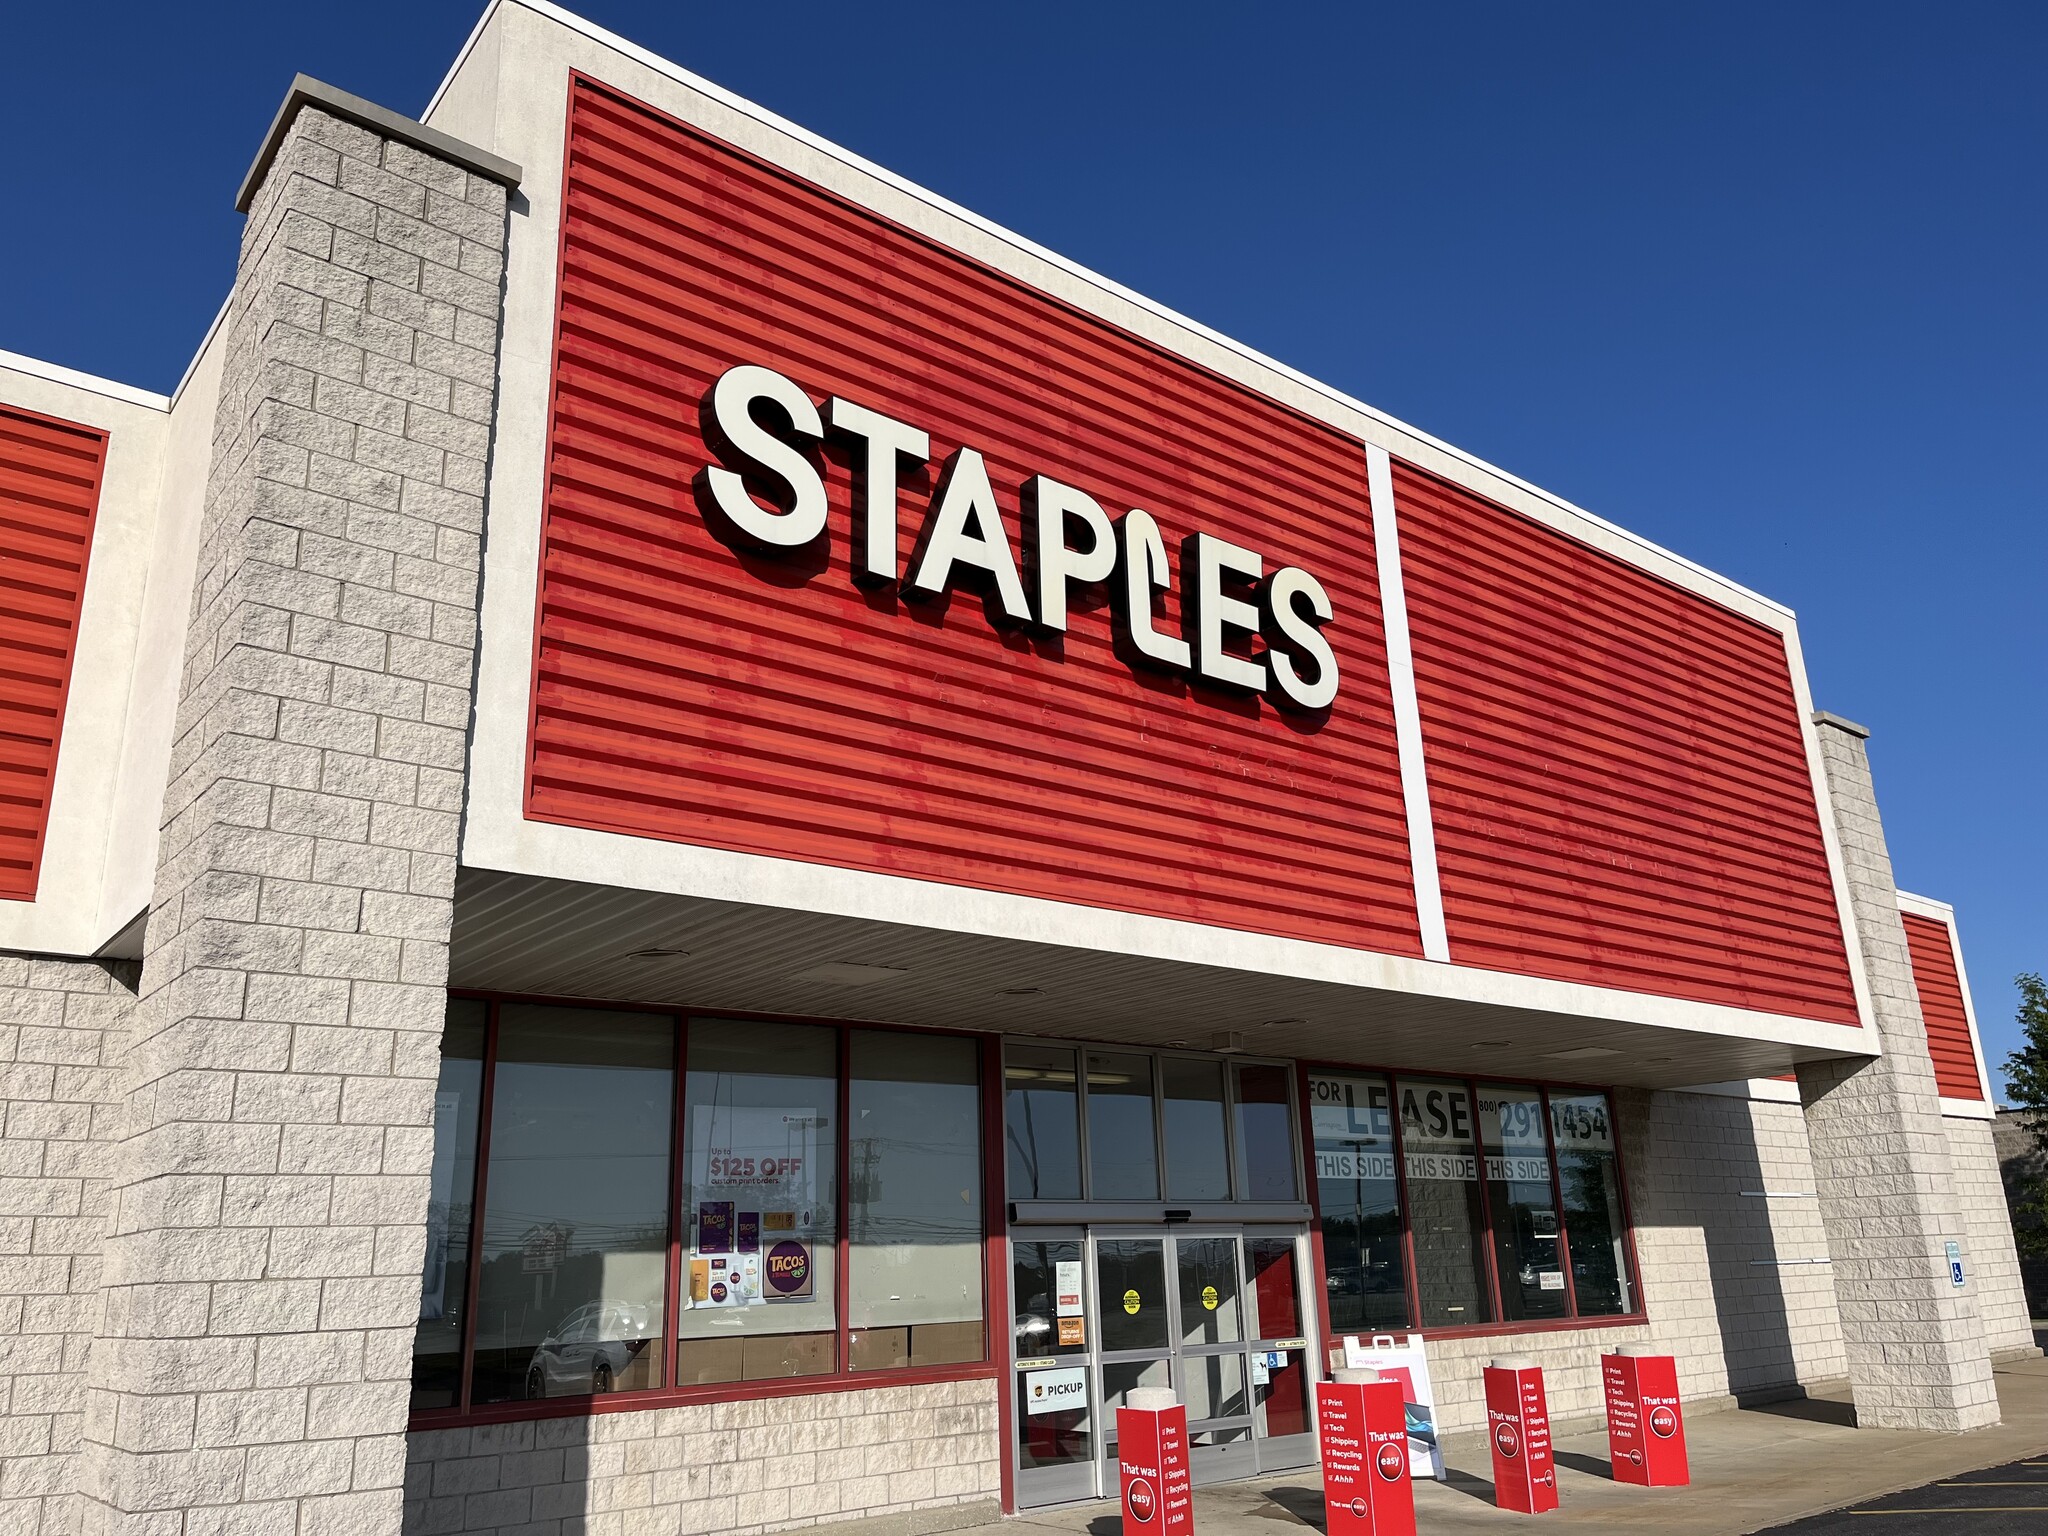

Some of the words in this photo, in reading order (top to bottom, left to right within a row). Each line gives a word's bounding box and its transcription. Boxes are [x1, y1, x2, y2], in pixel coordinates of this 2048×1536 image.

[705, 364, 1340, 709] STAPLES
[1309, 1081, 1341, 1101] FOR
[1345, 1084, 1470, 1138] LEASE
[1498, 1101, 1542, 1138] 291
[710, 1157, 756, 1176] $125
[760, 1157, 802, 1176] OFF
[1315, 1155, 1352, 1176] THIS
[1356, 1157, 1394, 1177] SIDE
[1404, 1157, 1436, 1177] THIS
[1441, 1158, 1475, 1178] SIDE
[1486, 1159, 1514, 1179] THIS
[1518, 1161, 1549, 1179] SIDE
[738, 1177, 756, 1186] print
[703, 1214, 726, 1225] TACOS
[739, 1223, 756, 1232] TACOS
[770, 1255, 805, 1272] TACOS
[712, 1287, 725, 1295] TACOS
[1610, 1367, 1622, 1375] Print
[1610, 1378, 1625, 1386] Travel
[1047, 1382, 1083, 1396] PICKUP
[1611, 1388, 1623, 1396] Tech
[1327, 1399, 1343, 1407] Print
[1527, 1394, 1538, 1402] Travel
[1612, 1398, 1634, 1408] Shipping
[1642, 1396, 1661, 1405] That
[1328, 1411, 1347, 1420] Travel
[1489, 1410, 1504, 1421] That
[1505, 1414, 1519, 1422] was
[1614, 1409, 1638, 1419] Recycling
[1529, 1416, 1545, 1425] Shipping
[1615, 1420, 1636, 1428] Rewards
[1654, 1417, 1672, 1426] easy
[1165, 1427, 1176, 1435] Print
[1329, 1424, 1344, 1432] Tech
[1531, 1428, 1547, 1437] Recycling
[1369, 1431, 1388, 1442] That
[1388, 1432, 1404, 1440] was
[1617, 1430, 1632, 1438] Ahhh
[1330, 1436, 1358, 1447] Shipping
[1499, 1434, 1514, 1445] easy
[1532, 1440, 1547, 1448] Rewards
[1167, 1440, 1179, 1450] Travel
[1331, 1449, 1363, 1460] Recycling
[1167, 1455, 1178, 1465] Tech
[1380, 1455, 1400, 1466] easy
[1121, 1462, 1139, 1475] That
[1140, 1467, 1157, 1477] was
[1332, 1462, 1360, 1471] Rewards
[1168, 1468, 1186, 1480] Shipping
[1334, 1475, 1354, 1483] Ahhh
[1169, 1482, 1188, 1495] Recycling
[1131, 1493, 1151, 1507] easy
[1170, 1498, 1188, 1509] Rewards
[1330, 1500, 1341, 1508] That
[1171, 1513, 1184, 1524] Ahhh
